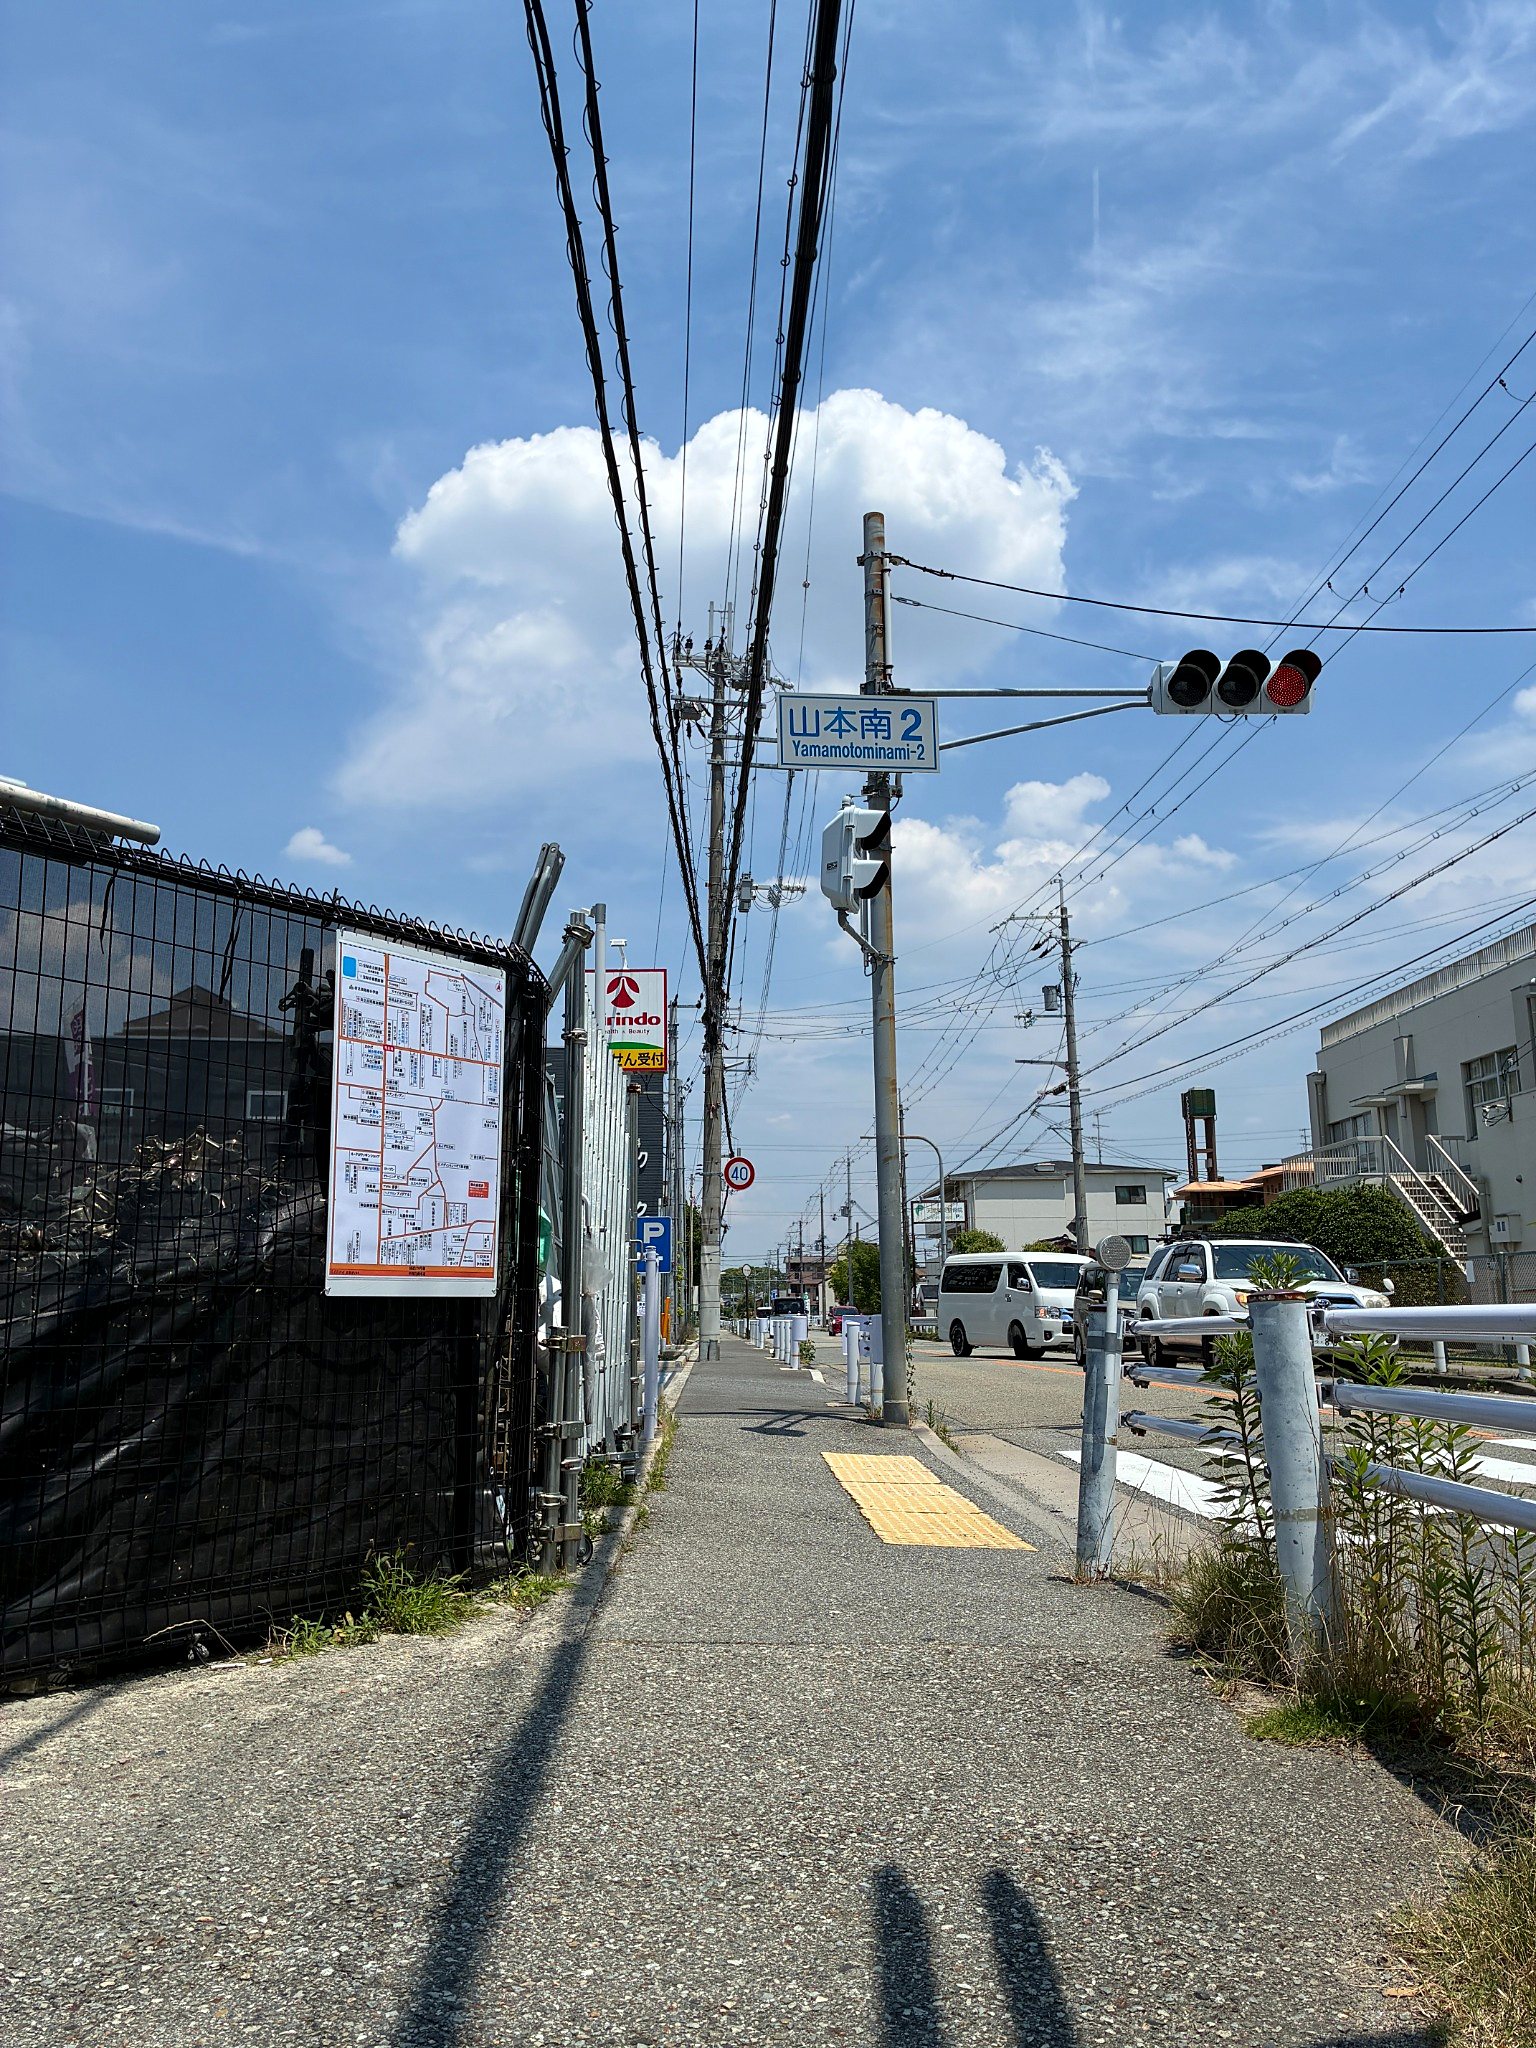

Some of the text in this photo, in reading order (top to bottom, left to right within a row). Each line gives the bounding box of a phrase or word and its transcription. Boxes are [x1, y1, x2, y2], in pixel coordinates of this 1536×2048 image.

[790, 706, 923, 742] 山本南2
[792, 739, 925, 761] Yamamotominami-2
[731, 1166, 748, 1180] 40
[643, 1222, 665, 1244] P
